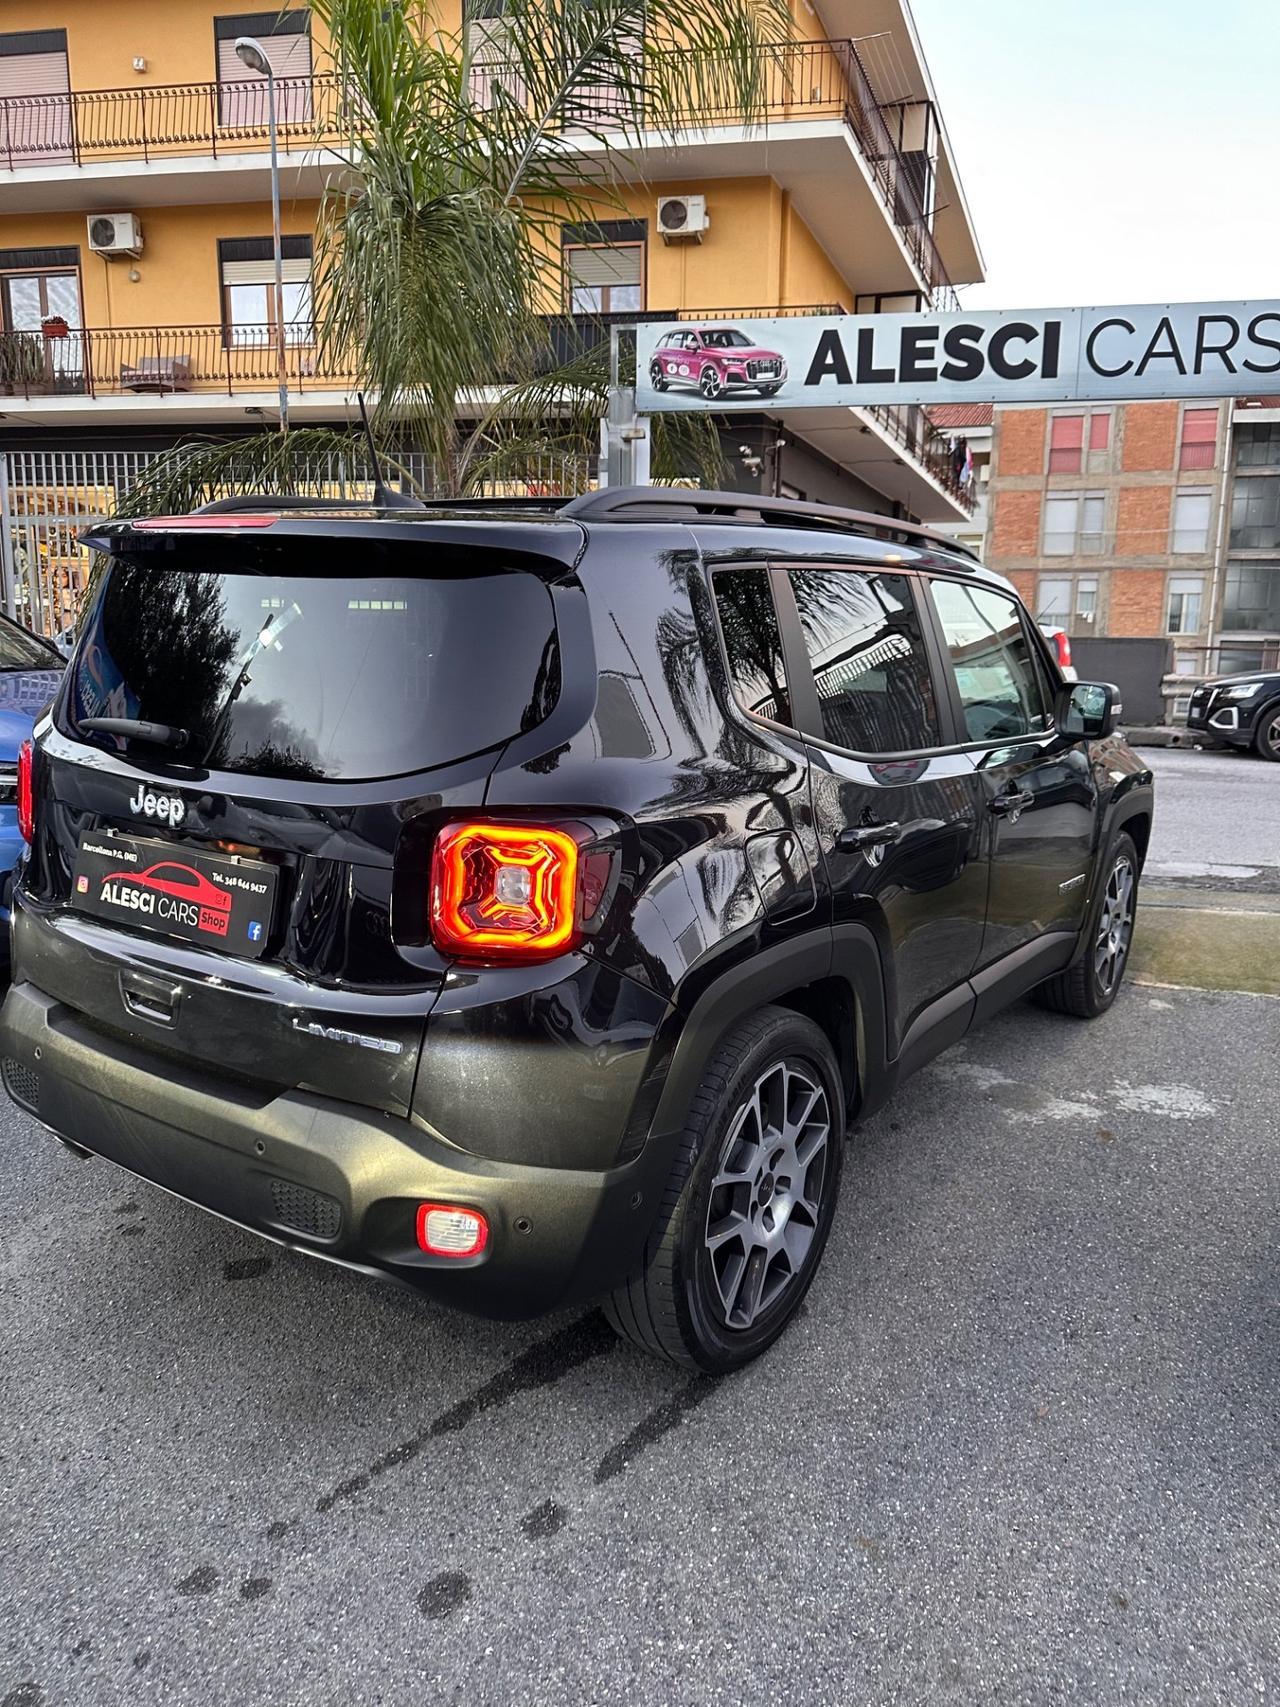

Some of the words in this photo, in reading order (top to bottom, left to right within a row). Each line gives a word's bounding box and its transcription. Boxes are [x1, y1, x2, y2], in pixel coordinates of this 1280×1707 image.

[804, 321, 1061, 386] ALESCI
[1086, 312, 1280, 378] CARS
[130, 785, 184, 827] Jeep
[82, 842, 113, 857] Barcellona
[225, 876, 237, 887] 348
[238, 879, 249, 890] 644
[250, 883, 267, 894] 9437
[100, 883, 155, 914] ALESCI
[158, 897, 199, 927] CARS
[201, 911, 226, 931] Shop
